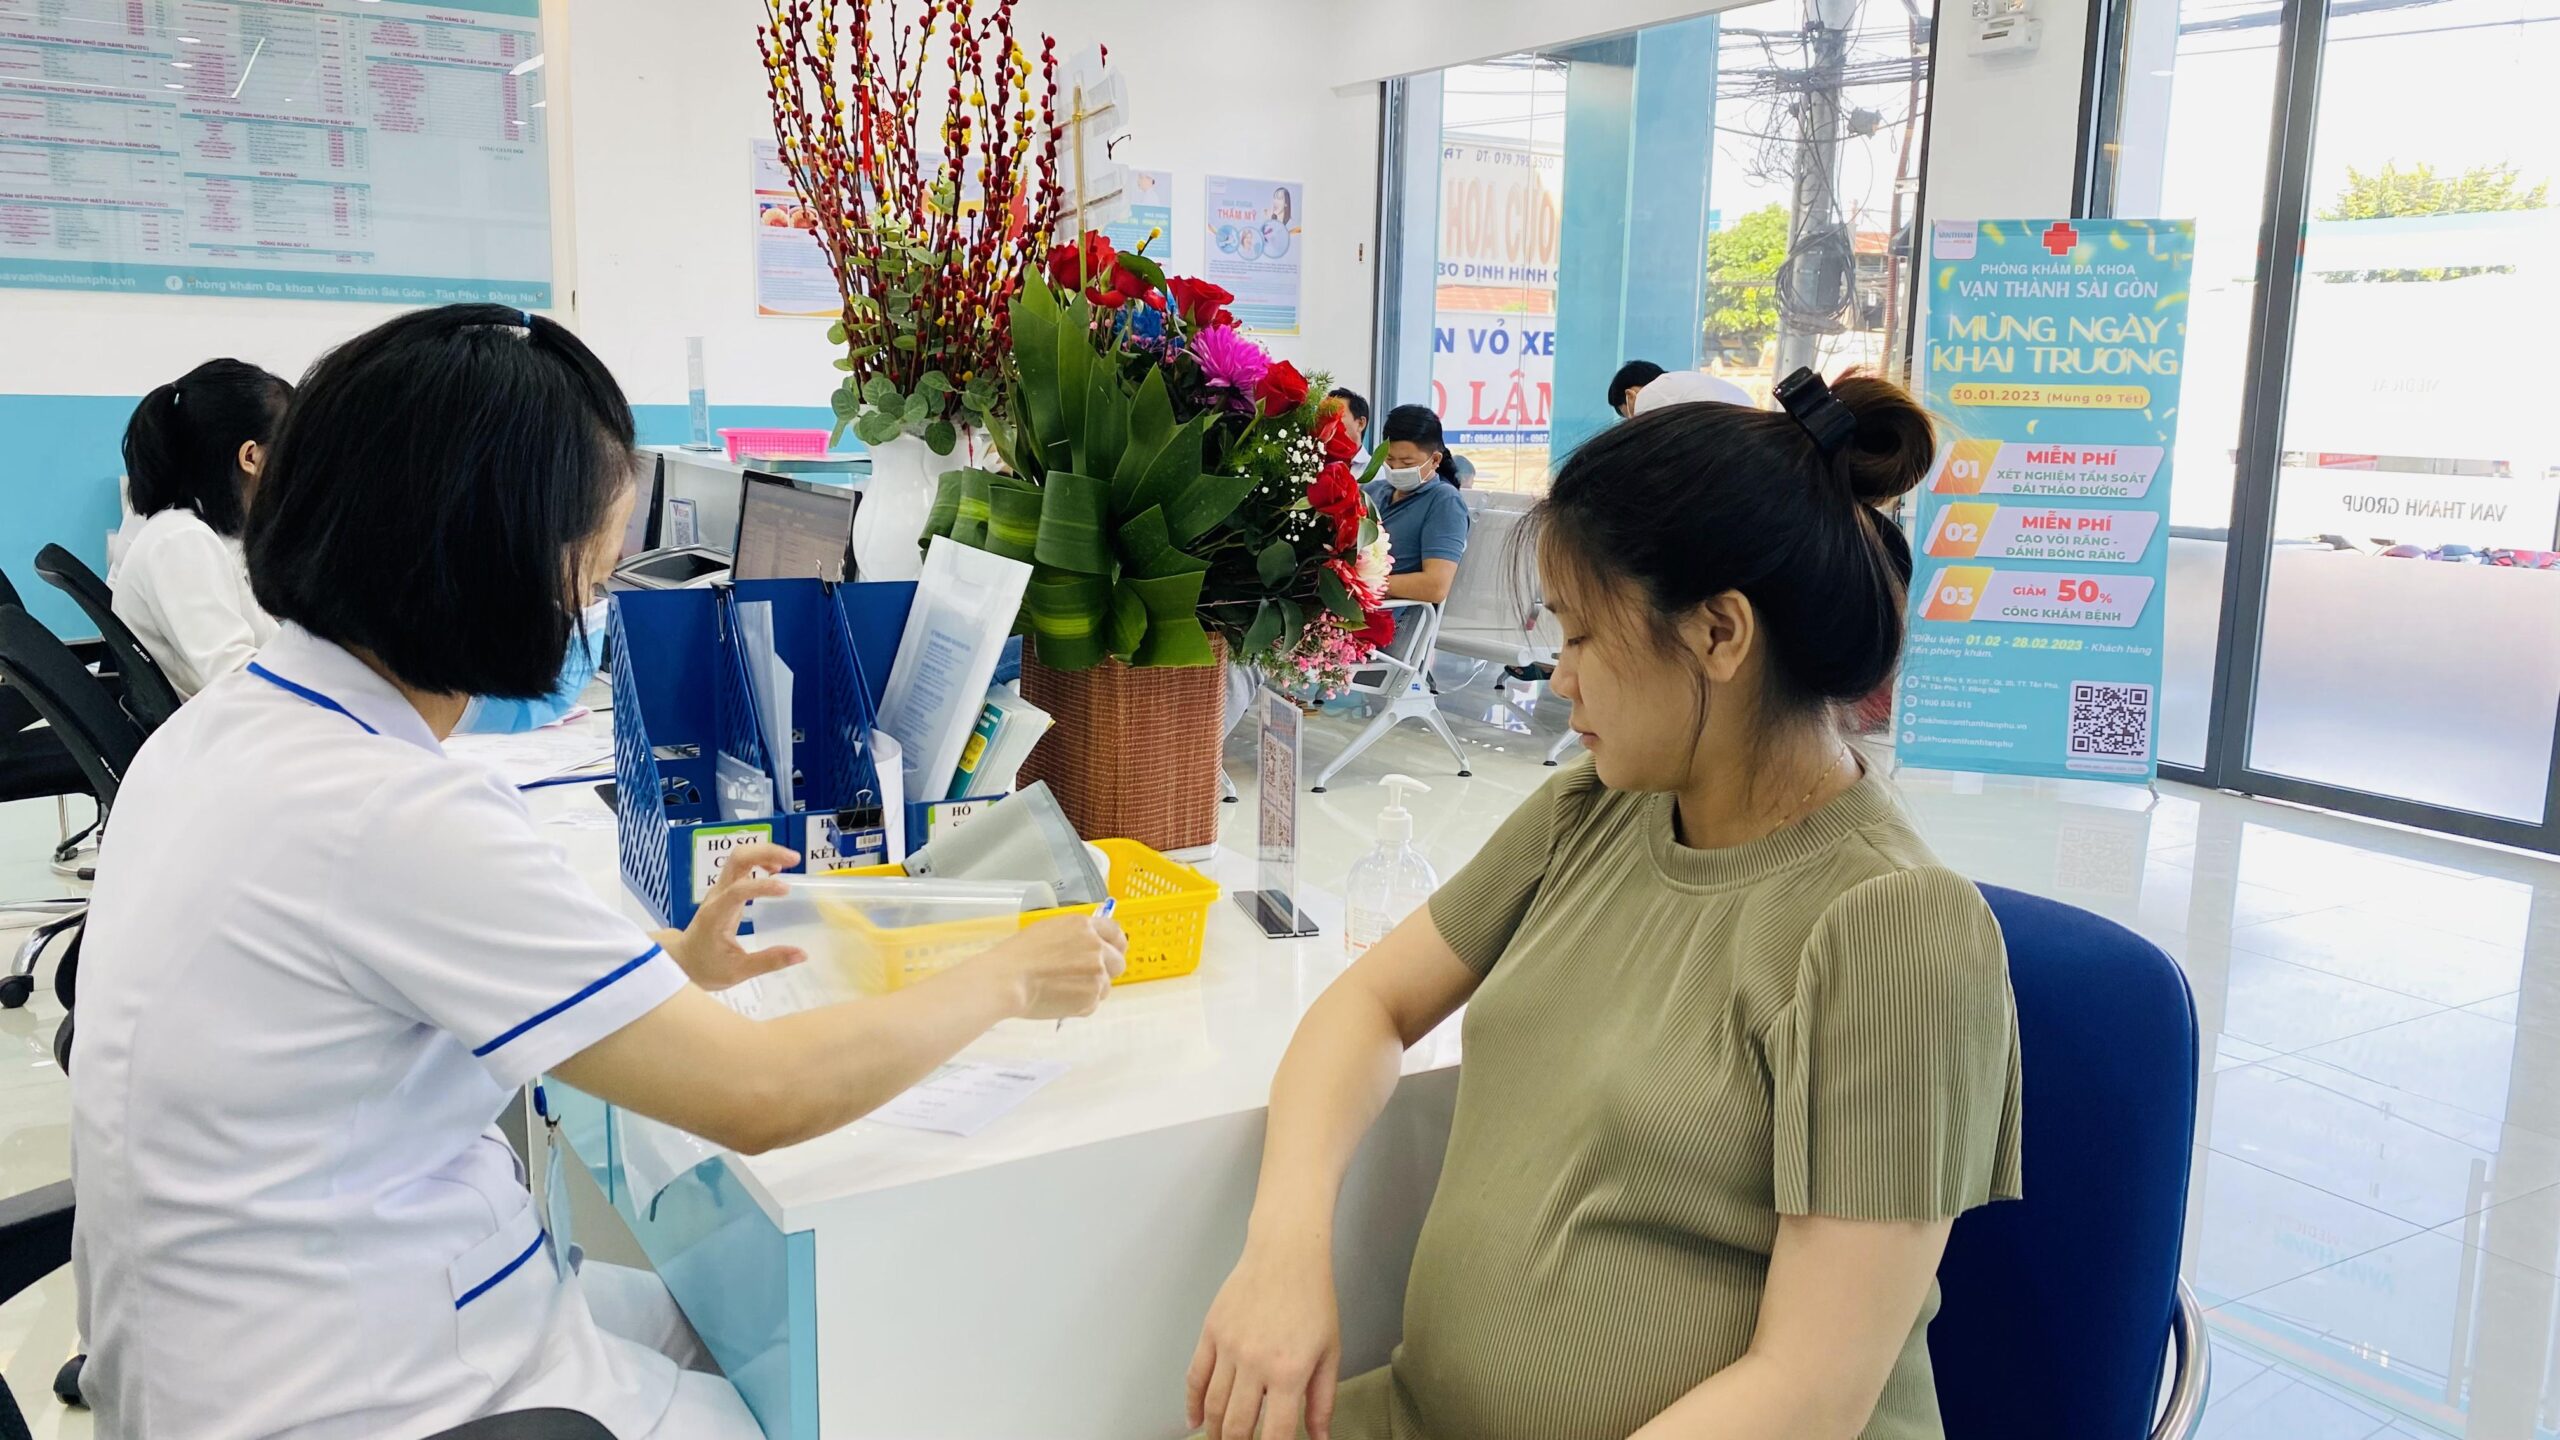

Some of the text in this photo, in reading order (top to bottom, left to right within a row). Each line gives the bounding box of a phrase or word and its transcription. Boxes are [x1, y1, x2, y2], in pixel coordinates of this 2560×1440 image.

[1981, 261, 2136, 276] PHÒNG KHÁM ĐA KHOA
[0, 273, 136, 286] avanthanhtanphu.vn
[286, 282, 313, 293] khoa
[1959, 278, 2158, 300] VẠN THÀNH SÀI GÒN
[1468, 318, 1510, 355] VỎ
[2068, 313, 2168, 344] NGÀY
[1932, 346, 2014, 373] KHAI
[1954, 389, 2040, 401] 30.01.2023
[2096, 394, 2112, 404] 09
[2118, 392, 2144, 405] Tết)
[2026, 445, 2116, 466] MIỄN PHÍ
[1952, 460, 1978, 479] 01
[1997, 469, 2020, 480] XÉT
[2022, 470, 2075, 483] NGHIỆM
[2110, 471, 2146, 483] SOÁT
[2013, 482, 2128, 497] ĐÁI THÁO ĐƯỜNG
[2022, 510, 2112, 531] MIỄN PHÍ
[1945, 522, 1978, 542] 02
[2015, 534, 2042, 546] CẠO
[2044, 532, 2069, 545] VÔI
[2073, 534, 2110, 546] RĂNG
[2006, 546, 2125, 560] ĐÁNH BÓNG RĂNG
[1941, 586, 1973, 606] 03
[2013, 579, 2112, 604] GIẢM 50%
[2002, 605, 2121, 623] CÔNG KHÁM BỆNH
[1930, 646, 1961, 657] phòng
[1965, 634, 2001, 646] 01.02
[2012, 637, 2083, 650] 28.02.2023
[2091, 643, 2123, 653] Khách
[2126, 645, 2152, 656] hàng
